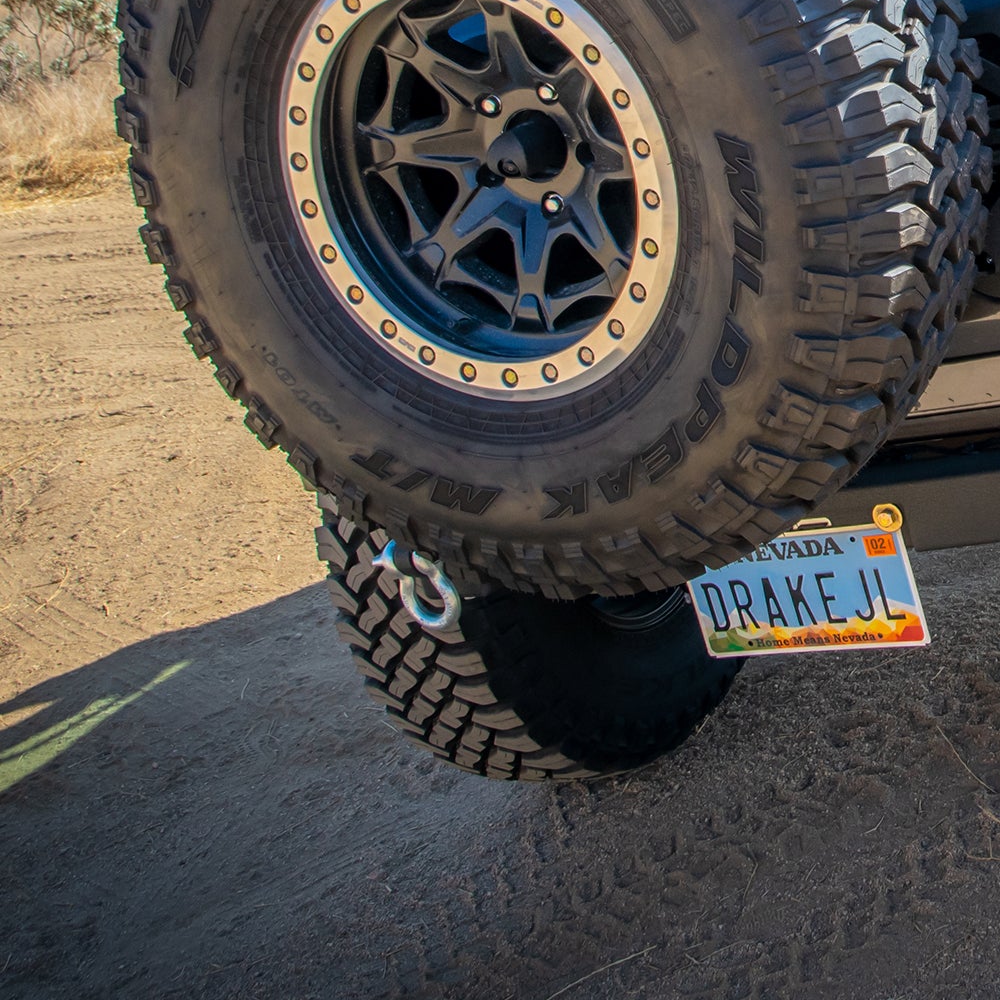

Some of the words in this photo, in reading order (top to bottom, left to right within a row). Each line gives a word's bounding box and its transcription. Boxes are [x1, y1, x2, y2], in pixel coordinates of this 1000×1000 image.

[869, 537, 887, 550] 02
[700, 571, 848, 632] DRAKE
[854, 567, 907, 622] JL
[756, 638, 790, 648] Home
[792, 635, 831, 647] Means
[833, 631, 877, 643] Nevada
